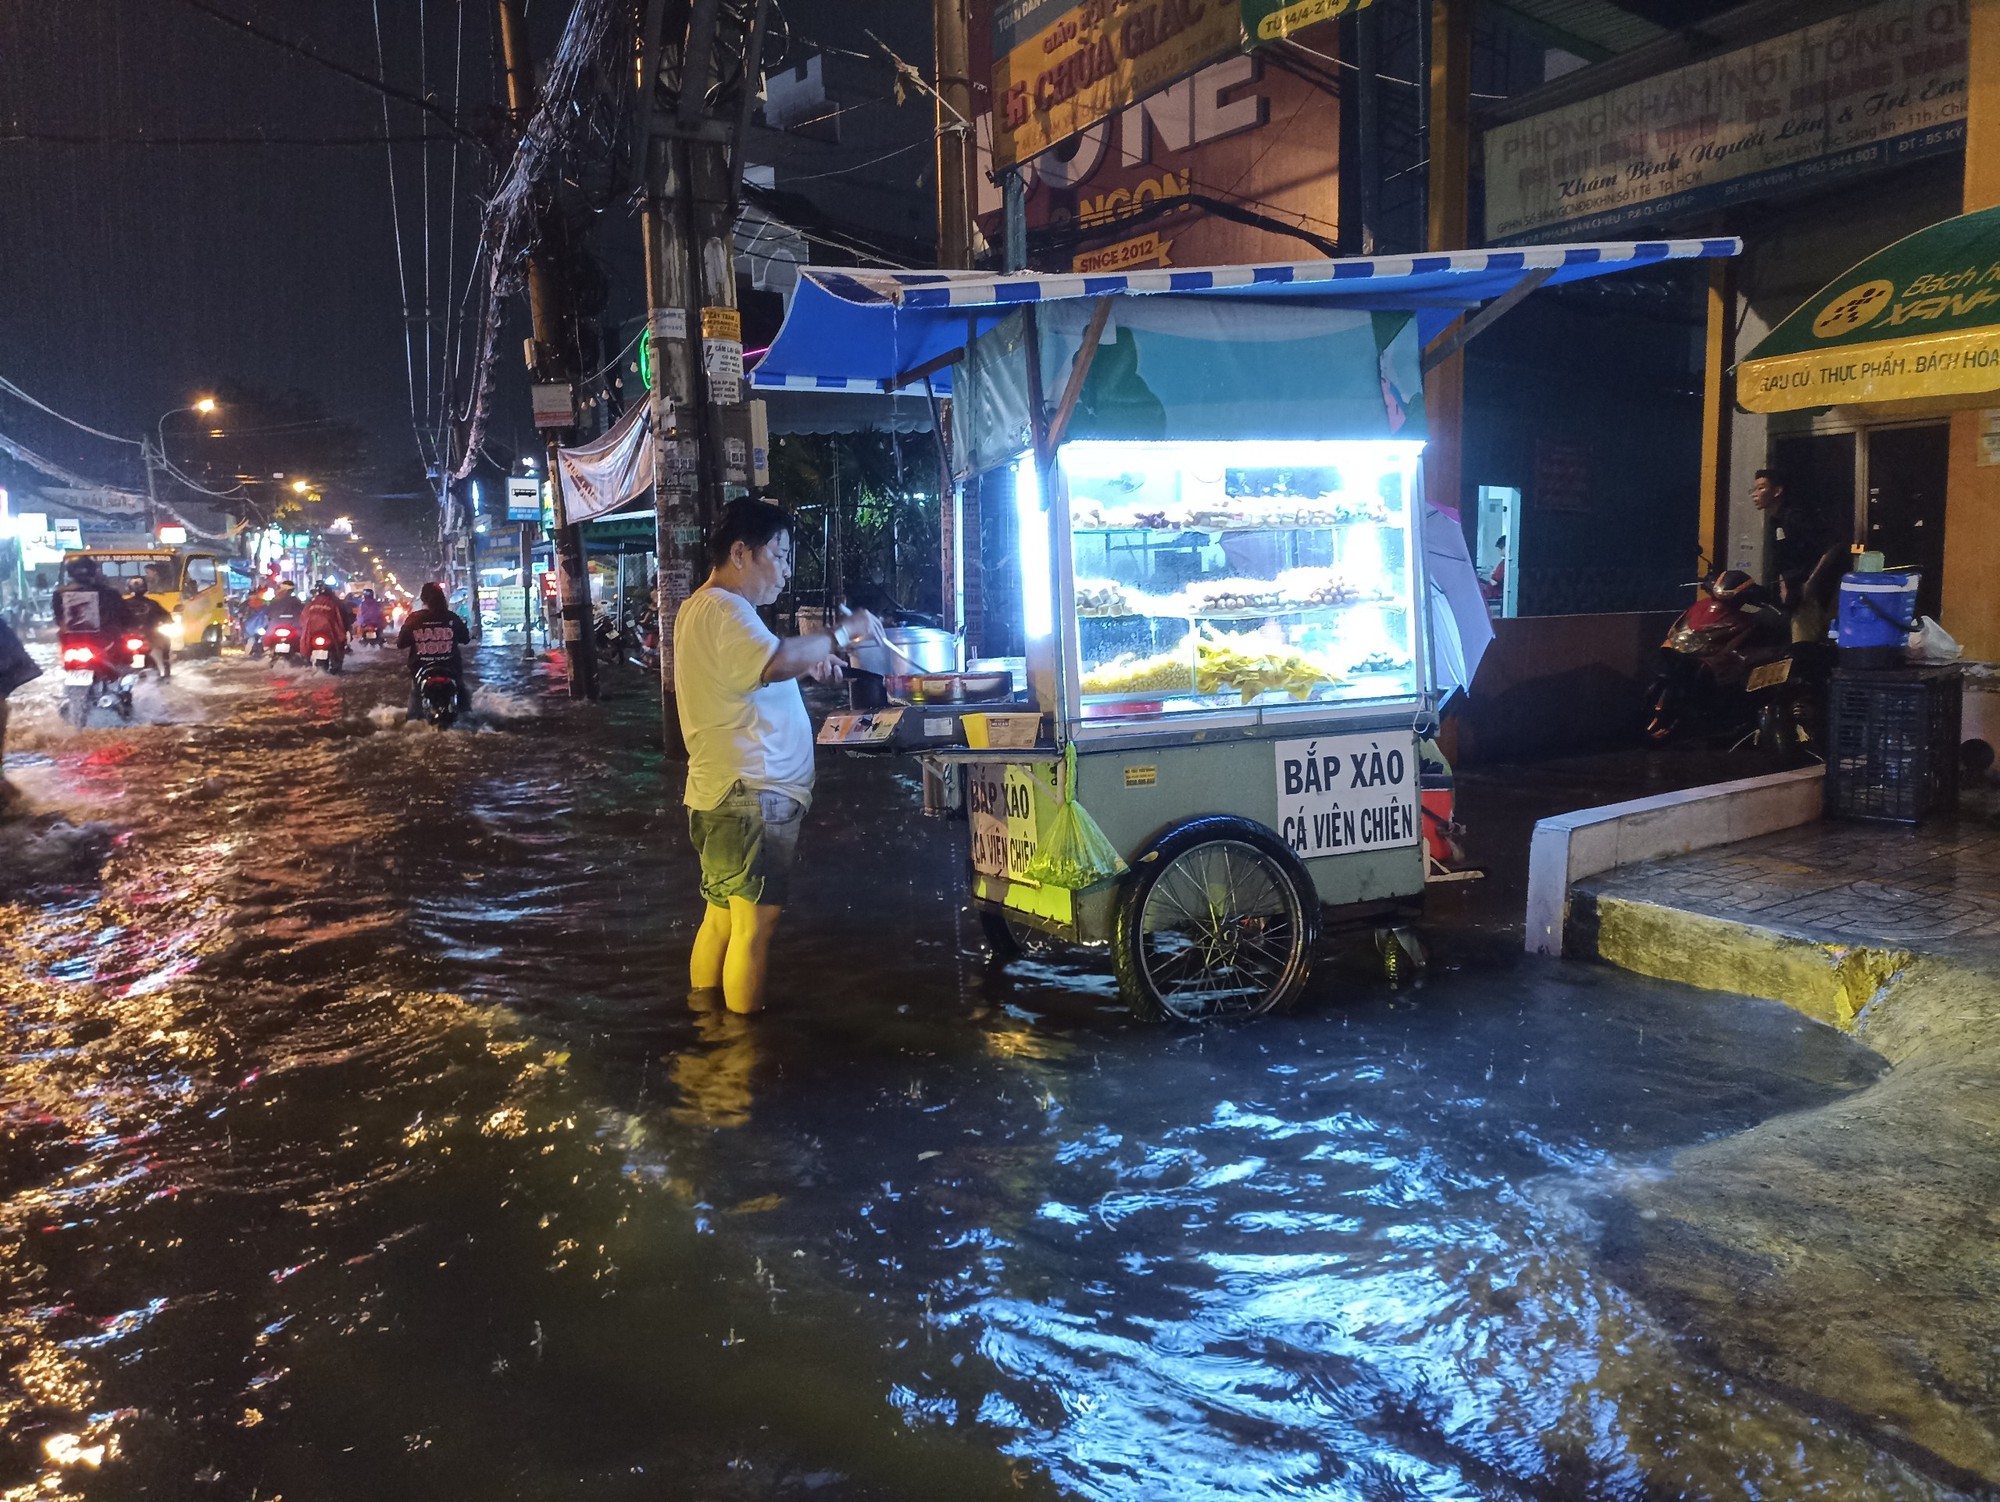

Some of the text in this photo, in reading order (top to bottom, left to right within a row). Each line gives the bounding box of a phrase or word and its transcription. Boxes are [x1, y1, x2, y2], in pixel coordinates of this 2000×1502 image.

[1032, 34, 1117, 113] CHÙA
[1556, 174, 1618, 201] Khám
[1627, 151, 1680, 181] Bệnh
[1690, 131, 1765, 162] Người
[1773, 117, 1824, 141] Lớn
[1837, 107, 1854, 124] &
[1920, 78, 1968, 102] Em
[1080, 239, 1154, 273] SINCE 2012
[1901, 265, 1978, 297] Bách
[1819, 363, 1858, 386] THỰC
[1861, 350, 1905, 380] PHẨM
[1915, 350, 1961, 374] BÁCH
[971, 765, 998, 816] BẮP
[1004, 774, 1030, 820] XÀO
[1284, 741, 1405, 796] BẮP XÀO
[987, 826, 1008, 869] VIÊN
[1283, 796, 1413, 852] CÁ VIÊN CHIÊN
